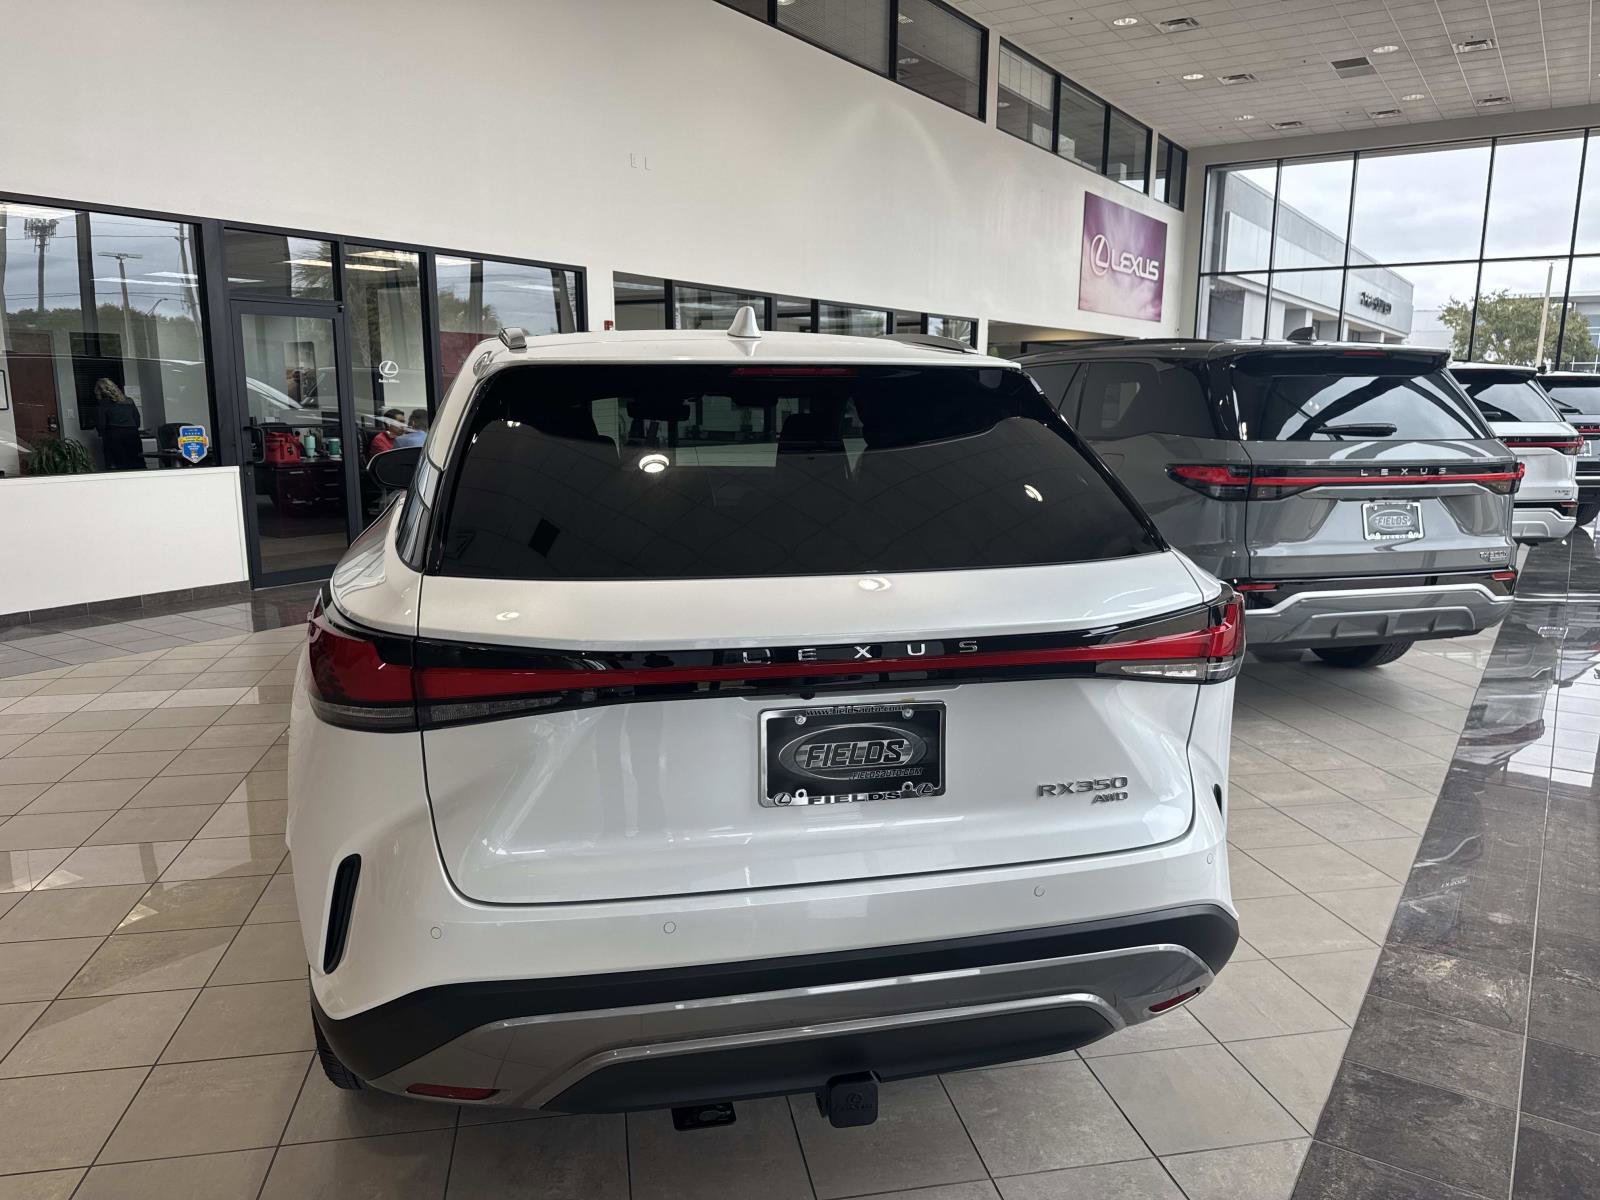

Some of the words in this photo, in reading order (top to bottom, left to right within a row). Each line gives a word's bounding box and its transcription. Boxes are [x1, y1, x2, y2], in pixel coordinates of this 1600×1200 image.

[1110, 247, 1160, 282] LEXUS
[1360, 466, 1448, 477] LEXUS
[1377, 515, 1409, 526] FIELDS
[742, 639, 979, 665] LEXUS
[803, 738, 905, 770] FIELDS
[1037, 776, 1128, 797] RX350
[807, 790, 902, 805] FIELDS
[1091, 791, 1129, 805] AWD
